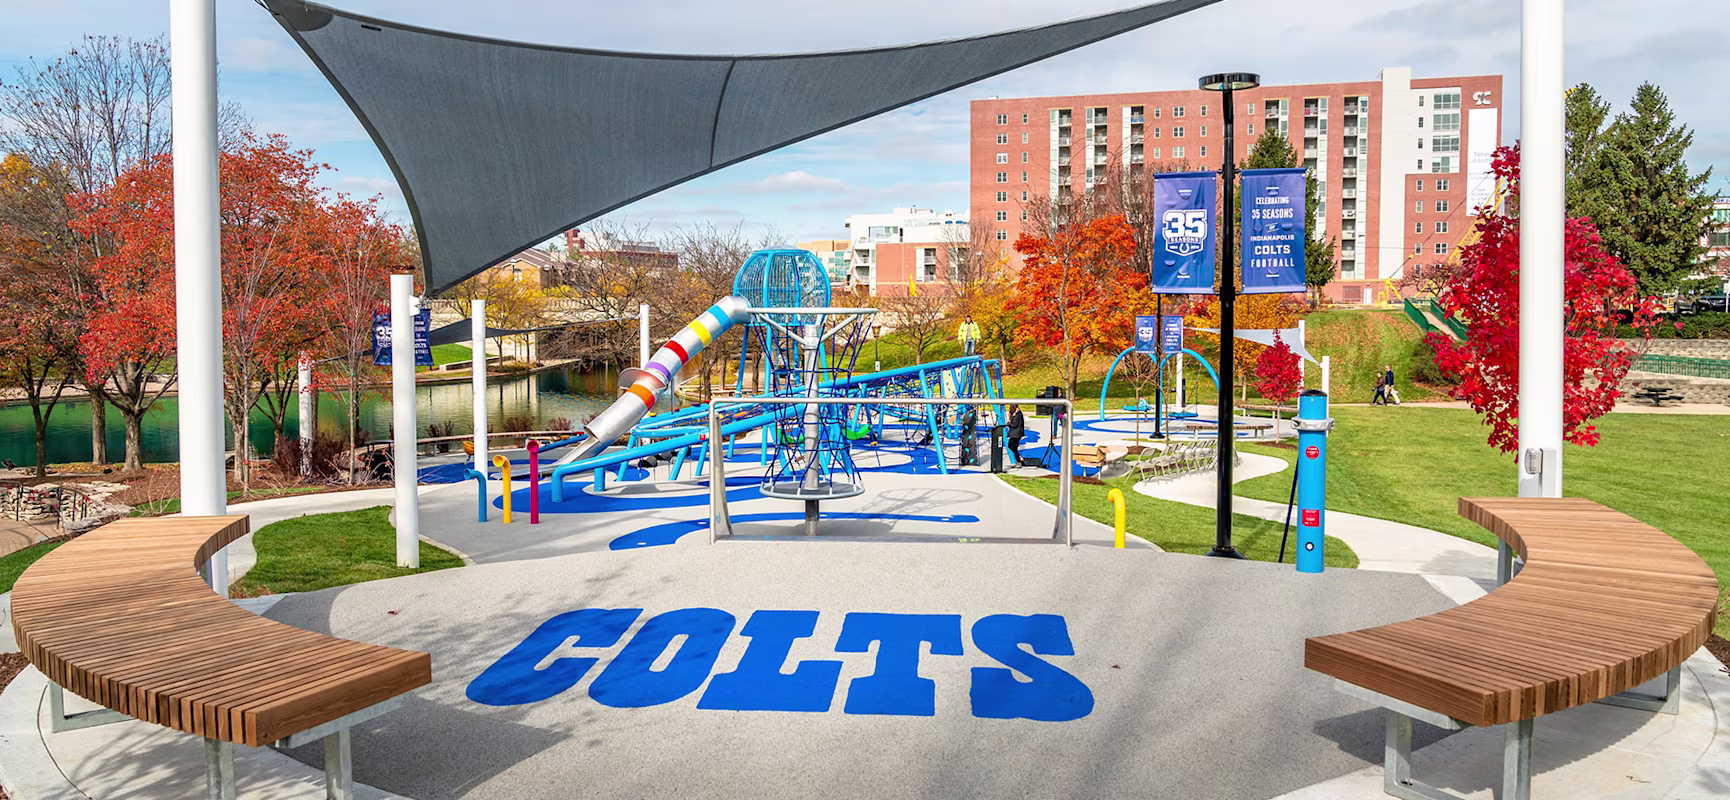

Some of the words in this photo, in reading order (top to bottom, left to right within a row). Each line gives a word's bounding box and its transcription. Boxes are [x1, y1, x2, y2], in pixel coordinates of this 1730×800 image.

[1255, 196, 1290, 205] CELEBRATING
[1251, 209, 1261, 219] 35
[1262, 207, 1294, 219] SEASONS
[1163, 210, 1206, 238] 35
[1254, 244, 1291, 255] COLTS
[1250, 257, 1295, 268] FOOTBALL
[465, 607, 1095, 722] COLTS
